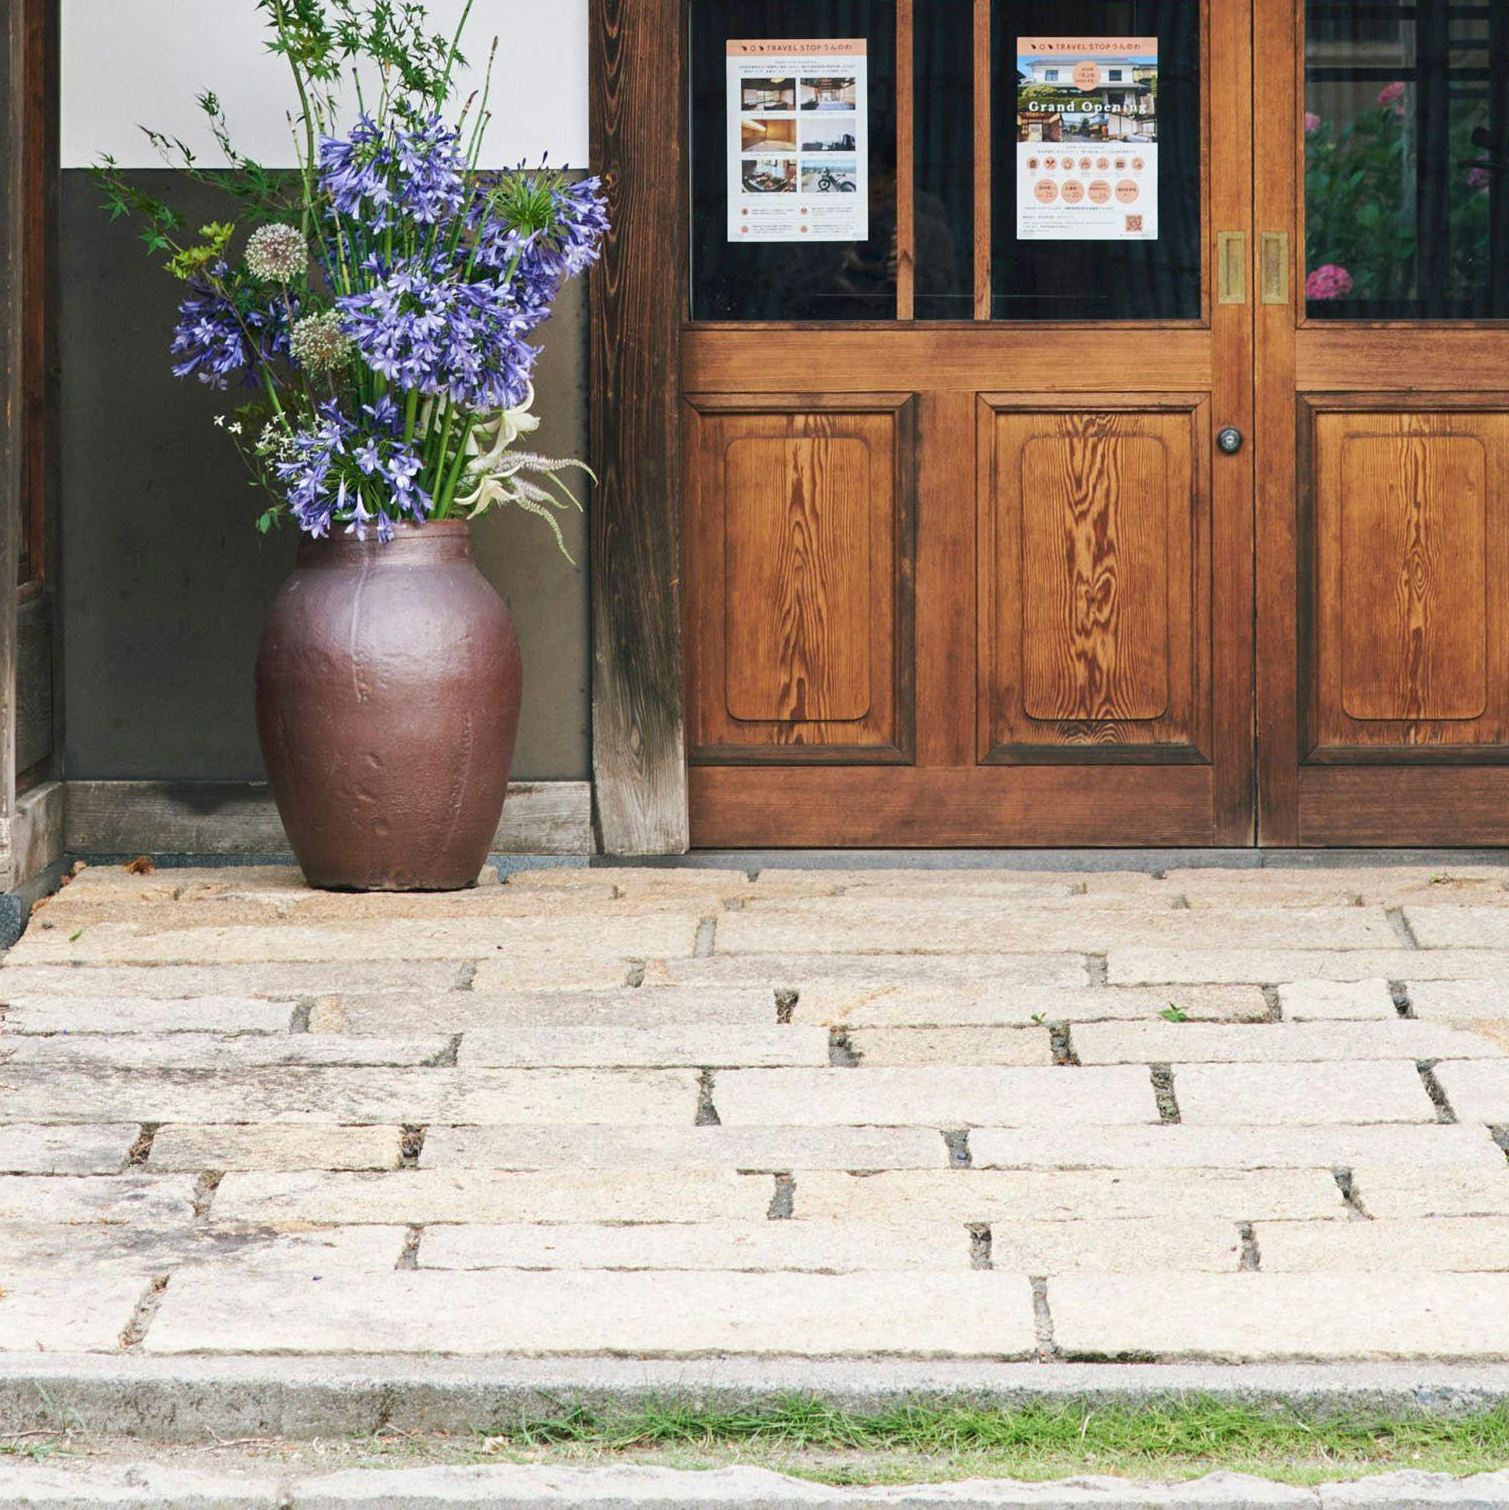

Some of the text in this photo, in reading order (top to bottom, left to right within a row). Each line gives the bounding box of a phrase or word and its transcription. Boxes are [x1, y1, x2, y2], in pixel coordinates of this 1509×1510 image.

[767, 44, 798, 52] TRAVEL
[800, 44, 821, 52] STOP
[1056, 43, 1086, 51] TRAVEL
[1089, 43, 1111, 51] STOP
[1028, 101, 1147, 115] Grand Opening
